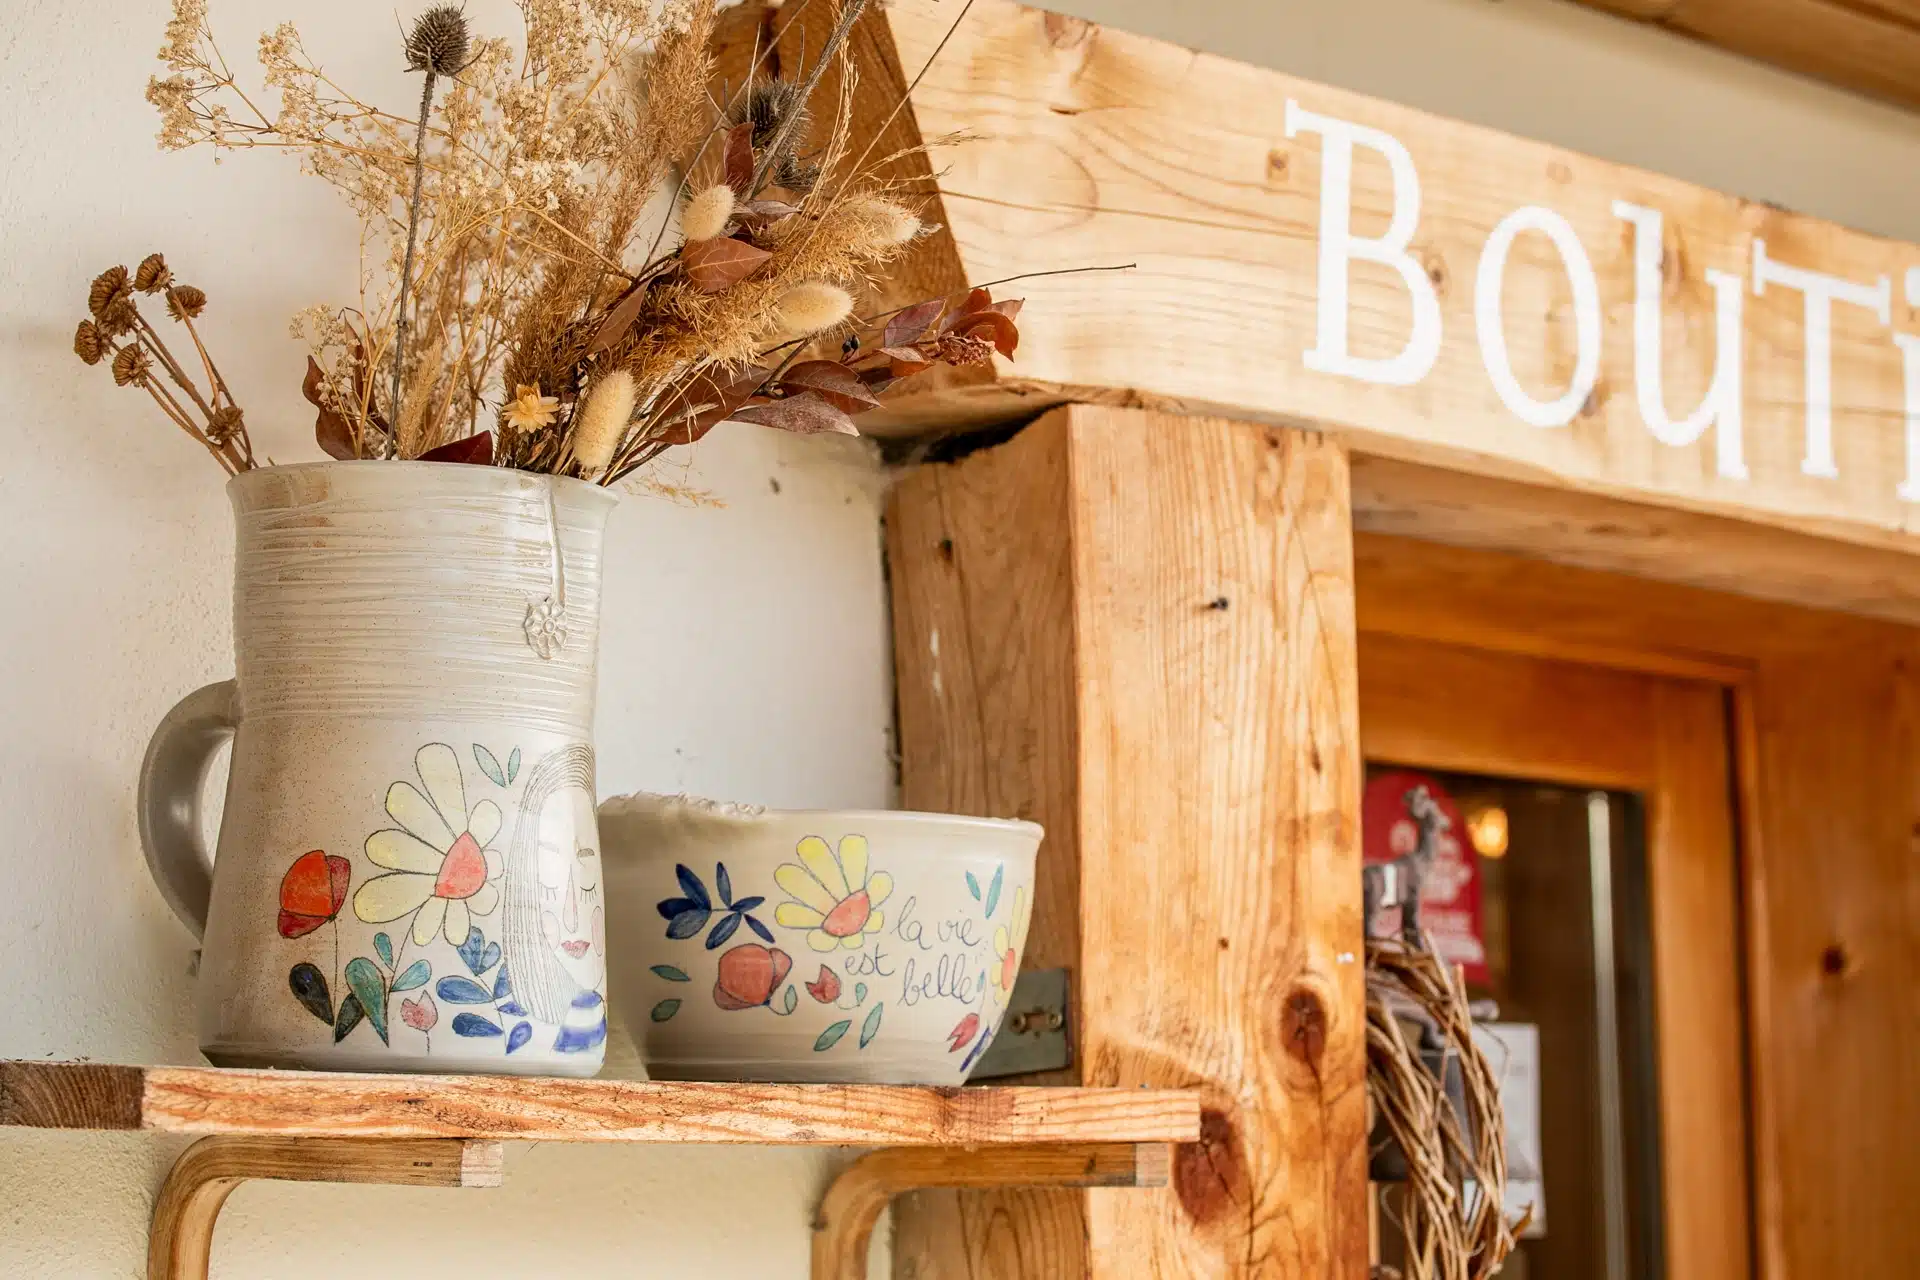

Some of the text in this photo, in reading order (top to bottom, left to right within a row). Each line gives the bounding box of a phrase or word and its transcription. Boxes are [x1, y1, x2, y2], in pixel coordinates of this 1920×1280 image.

[889, 896, 982, 950] la vie
[844, 943, 975, 1007] est belle
